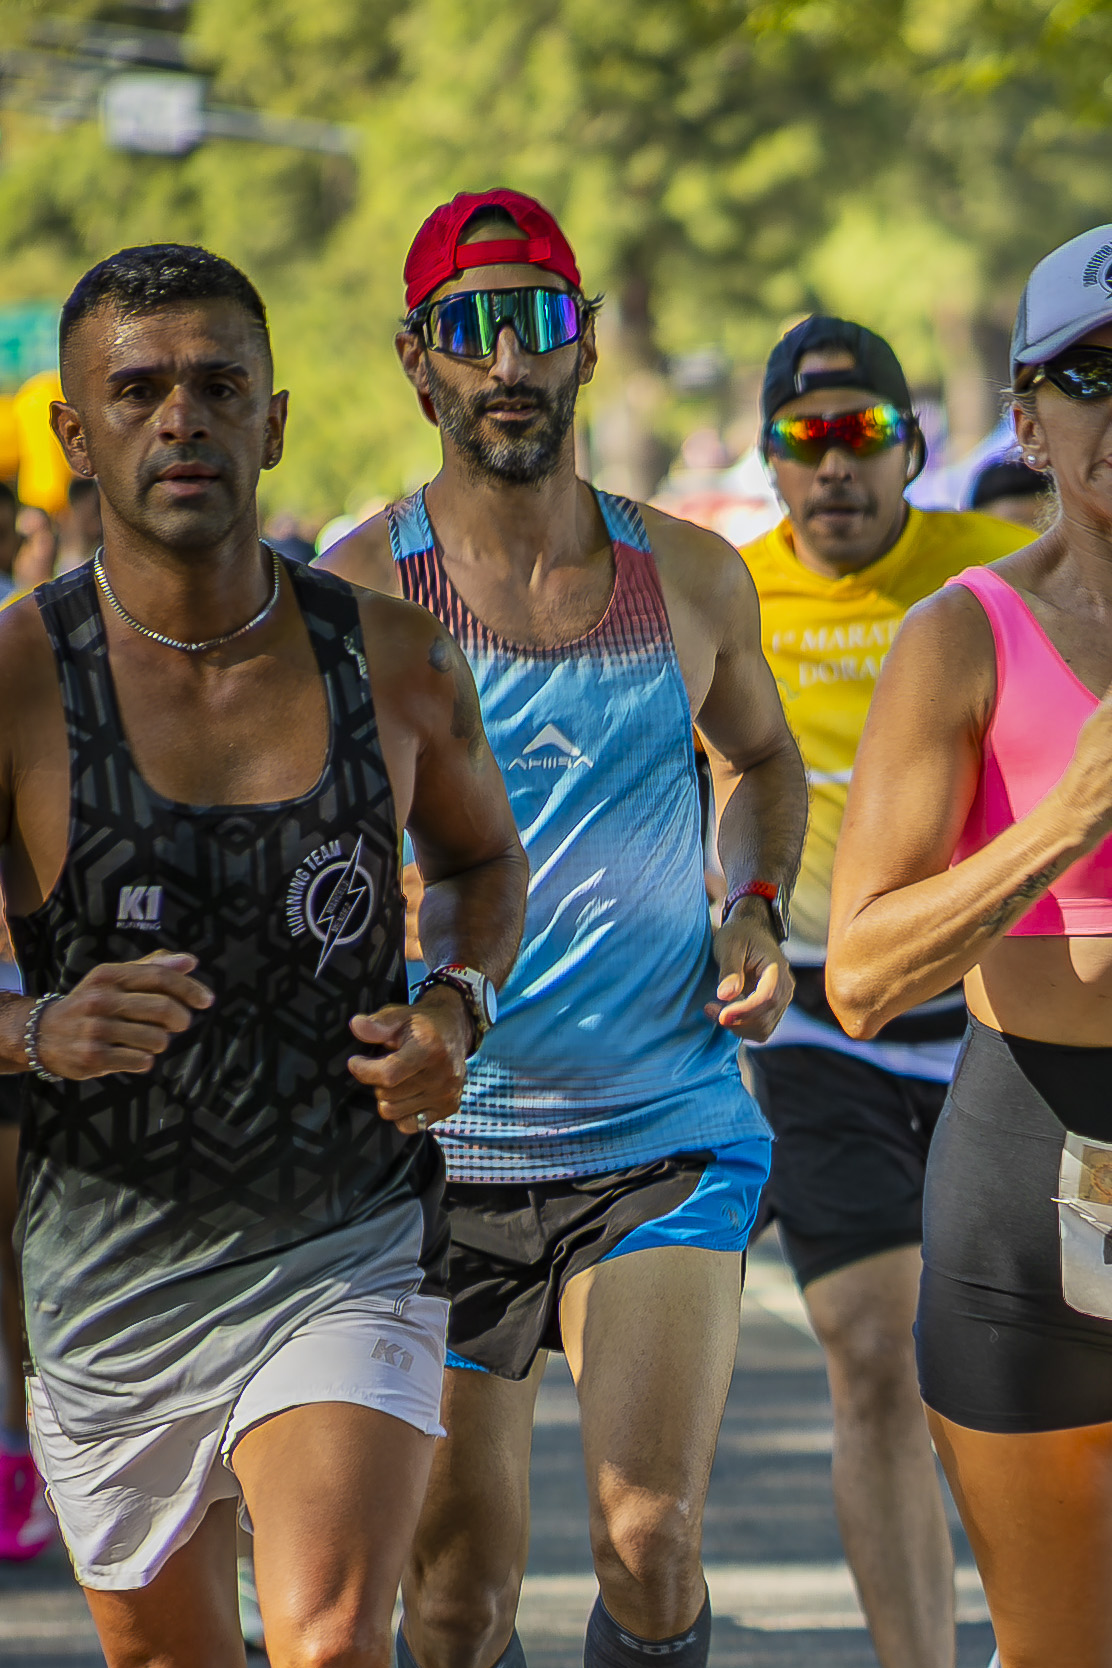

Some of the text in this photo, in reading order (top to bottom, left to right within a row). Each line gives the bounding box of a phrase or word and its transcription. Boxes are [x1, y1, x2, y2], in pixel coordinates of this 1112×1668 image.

[117, 885, 163, 920] K1
[286, 839, 342, 937] RUNNING TEAM
[369, 1338, 415, 1373] K1
